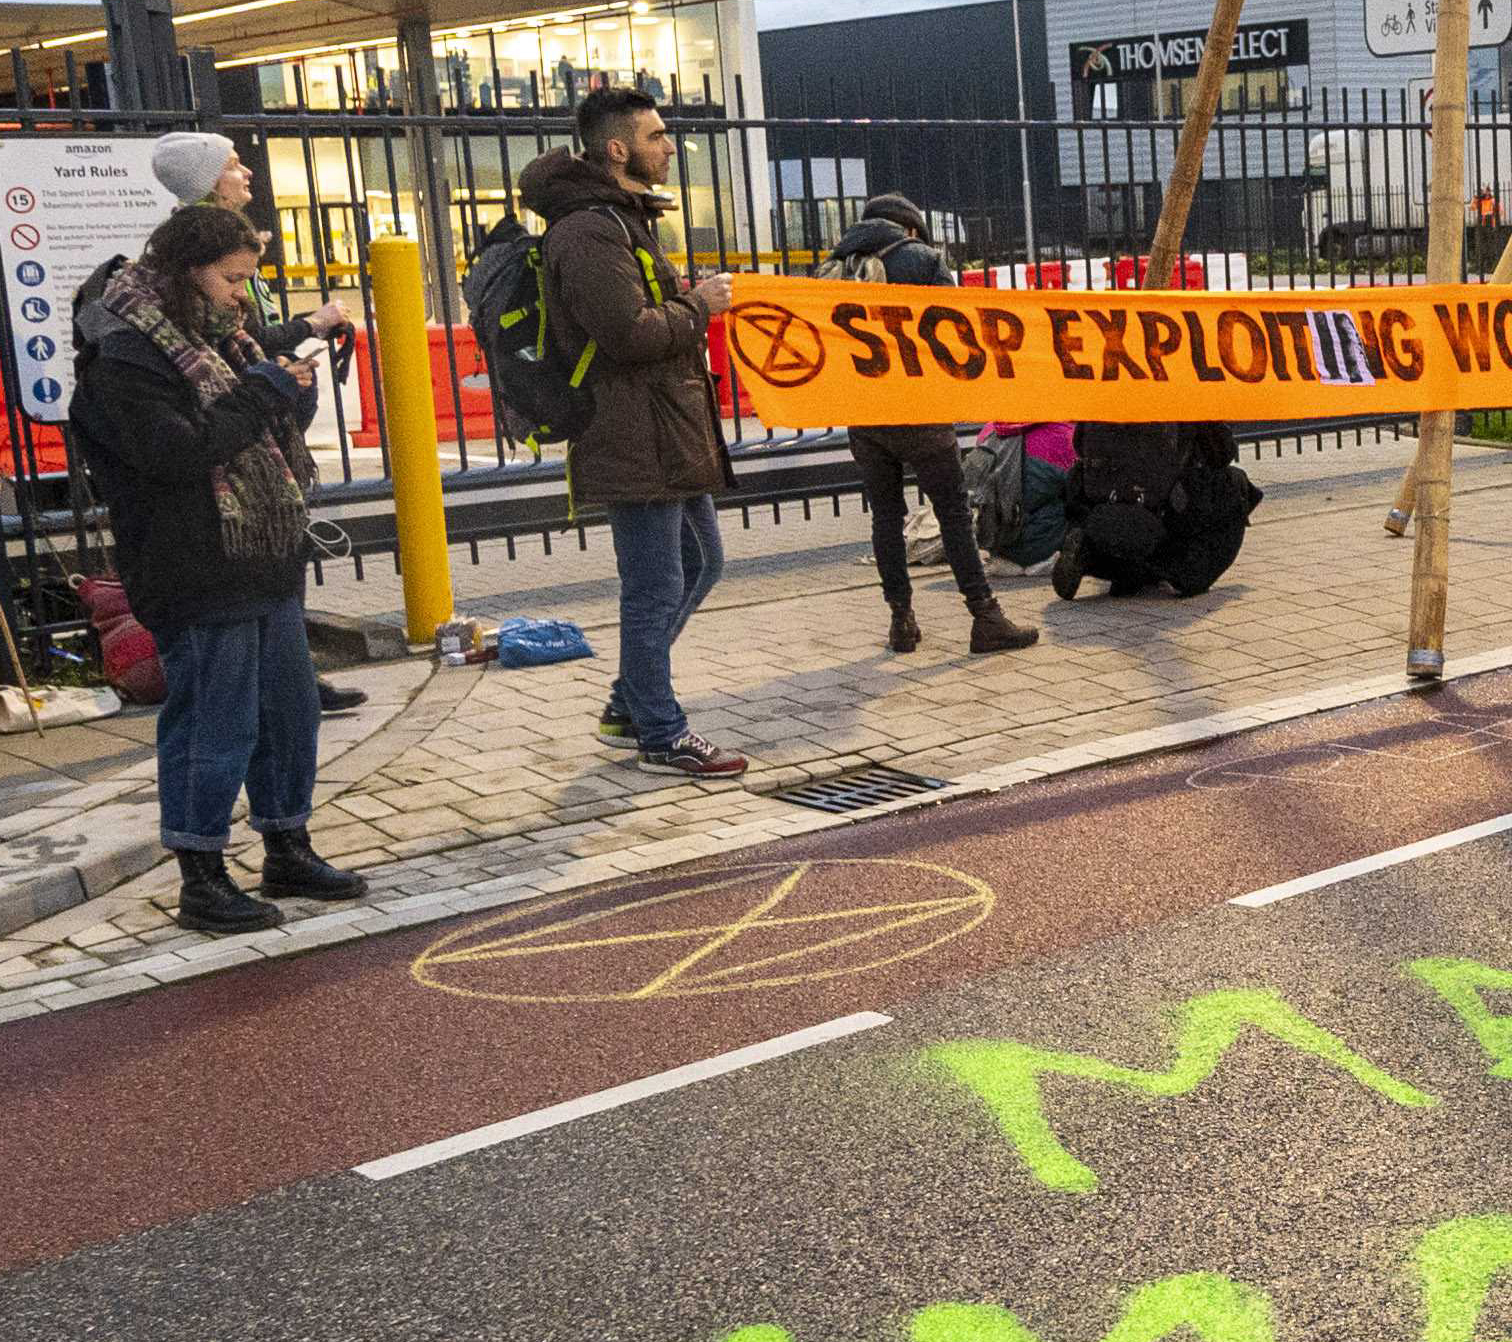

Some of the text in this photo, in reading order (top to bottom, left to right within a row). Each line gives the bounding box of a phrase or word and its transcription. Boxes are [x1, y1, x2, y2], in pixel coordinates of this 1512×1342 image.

[1231, 27, 1289, 61] ELECT
[65, 144, 112, 155] amazon
[53, 165, 129, 178] Yard Rules
[11, 194, 29, 207] 15
[831, 302, 1025, 381] STOP
